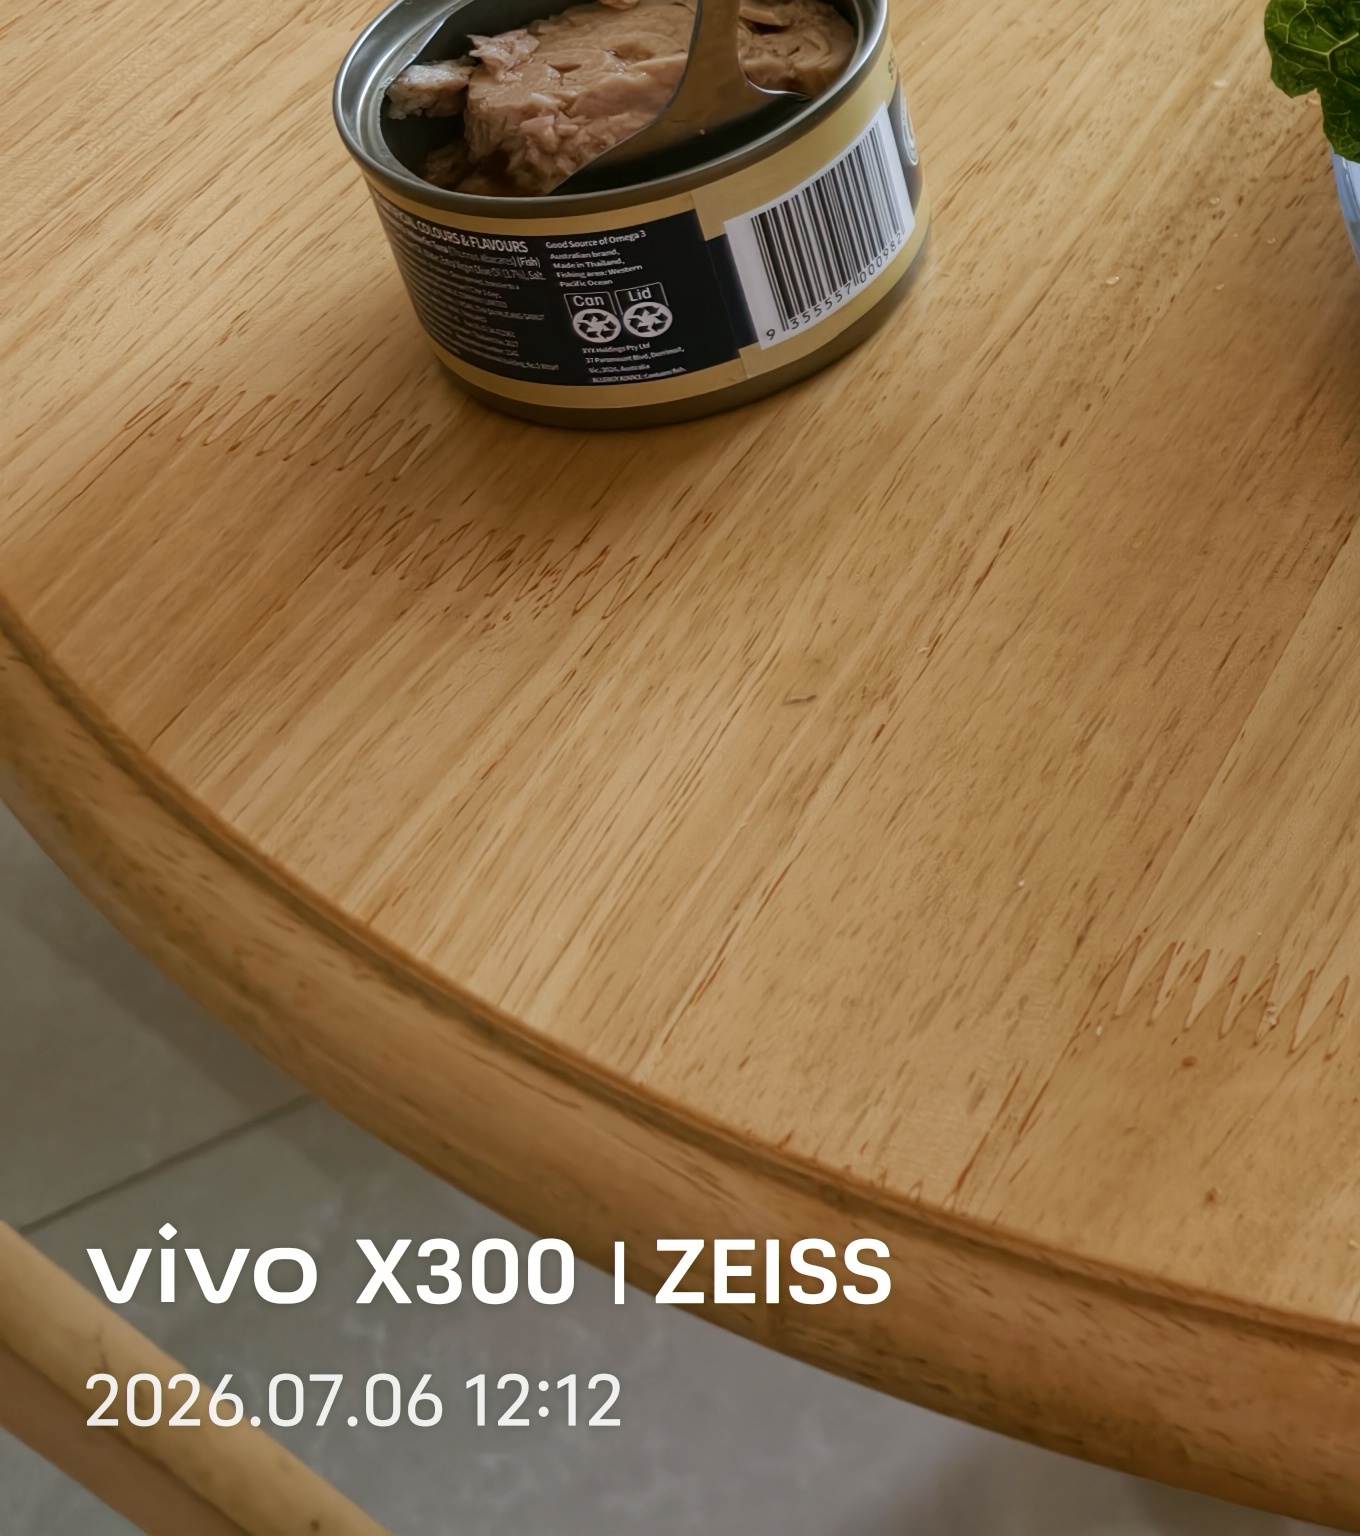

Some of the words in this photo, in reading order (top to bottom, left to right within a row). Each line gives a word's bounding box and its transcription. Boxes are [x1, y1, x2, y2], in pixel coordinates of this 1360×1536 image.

[469, 236, 529, 253] FLAVOURS
[545, 241, 569, 250] Good
[568, 238, 598, 249] Source
[608, 233, 640, 245] Omega
[553, 261, 576, 269] Made
[765, 327, 777, 341] 9
[788, 281, 853, 331] 355557
[858, 231, 904, 284] 000982
[572, 295, 605, 308] Can
[628, 287, 652, 303] Lid
